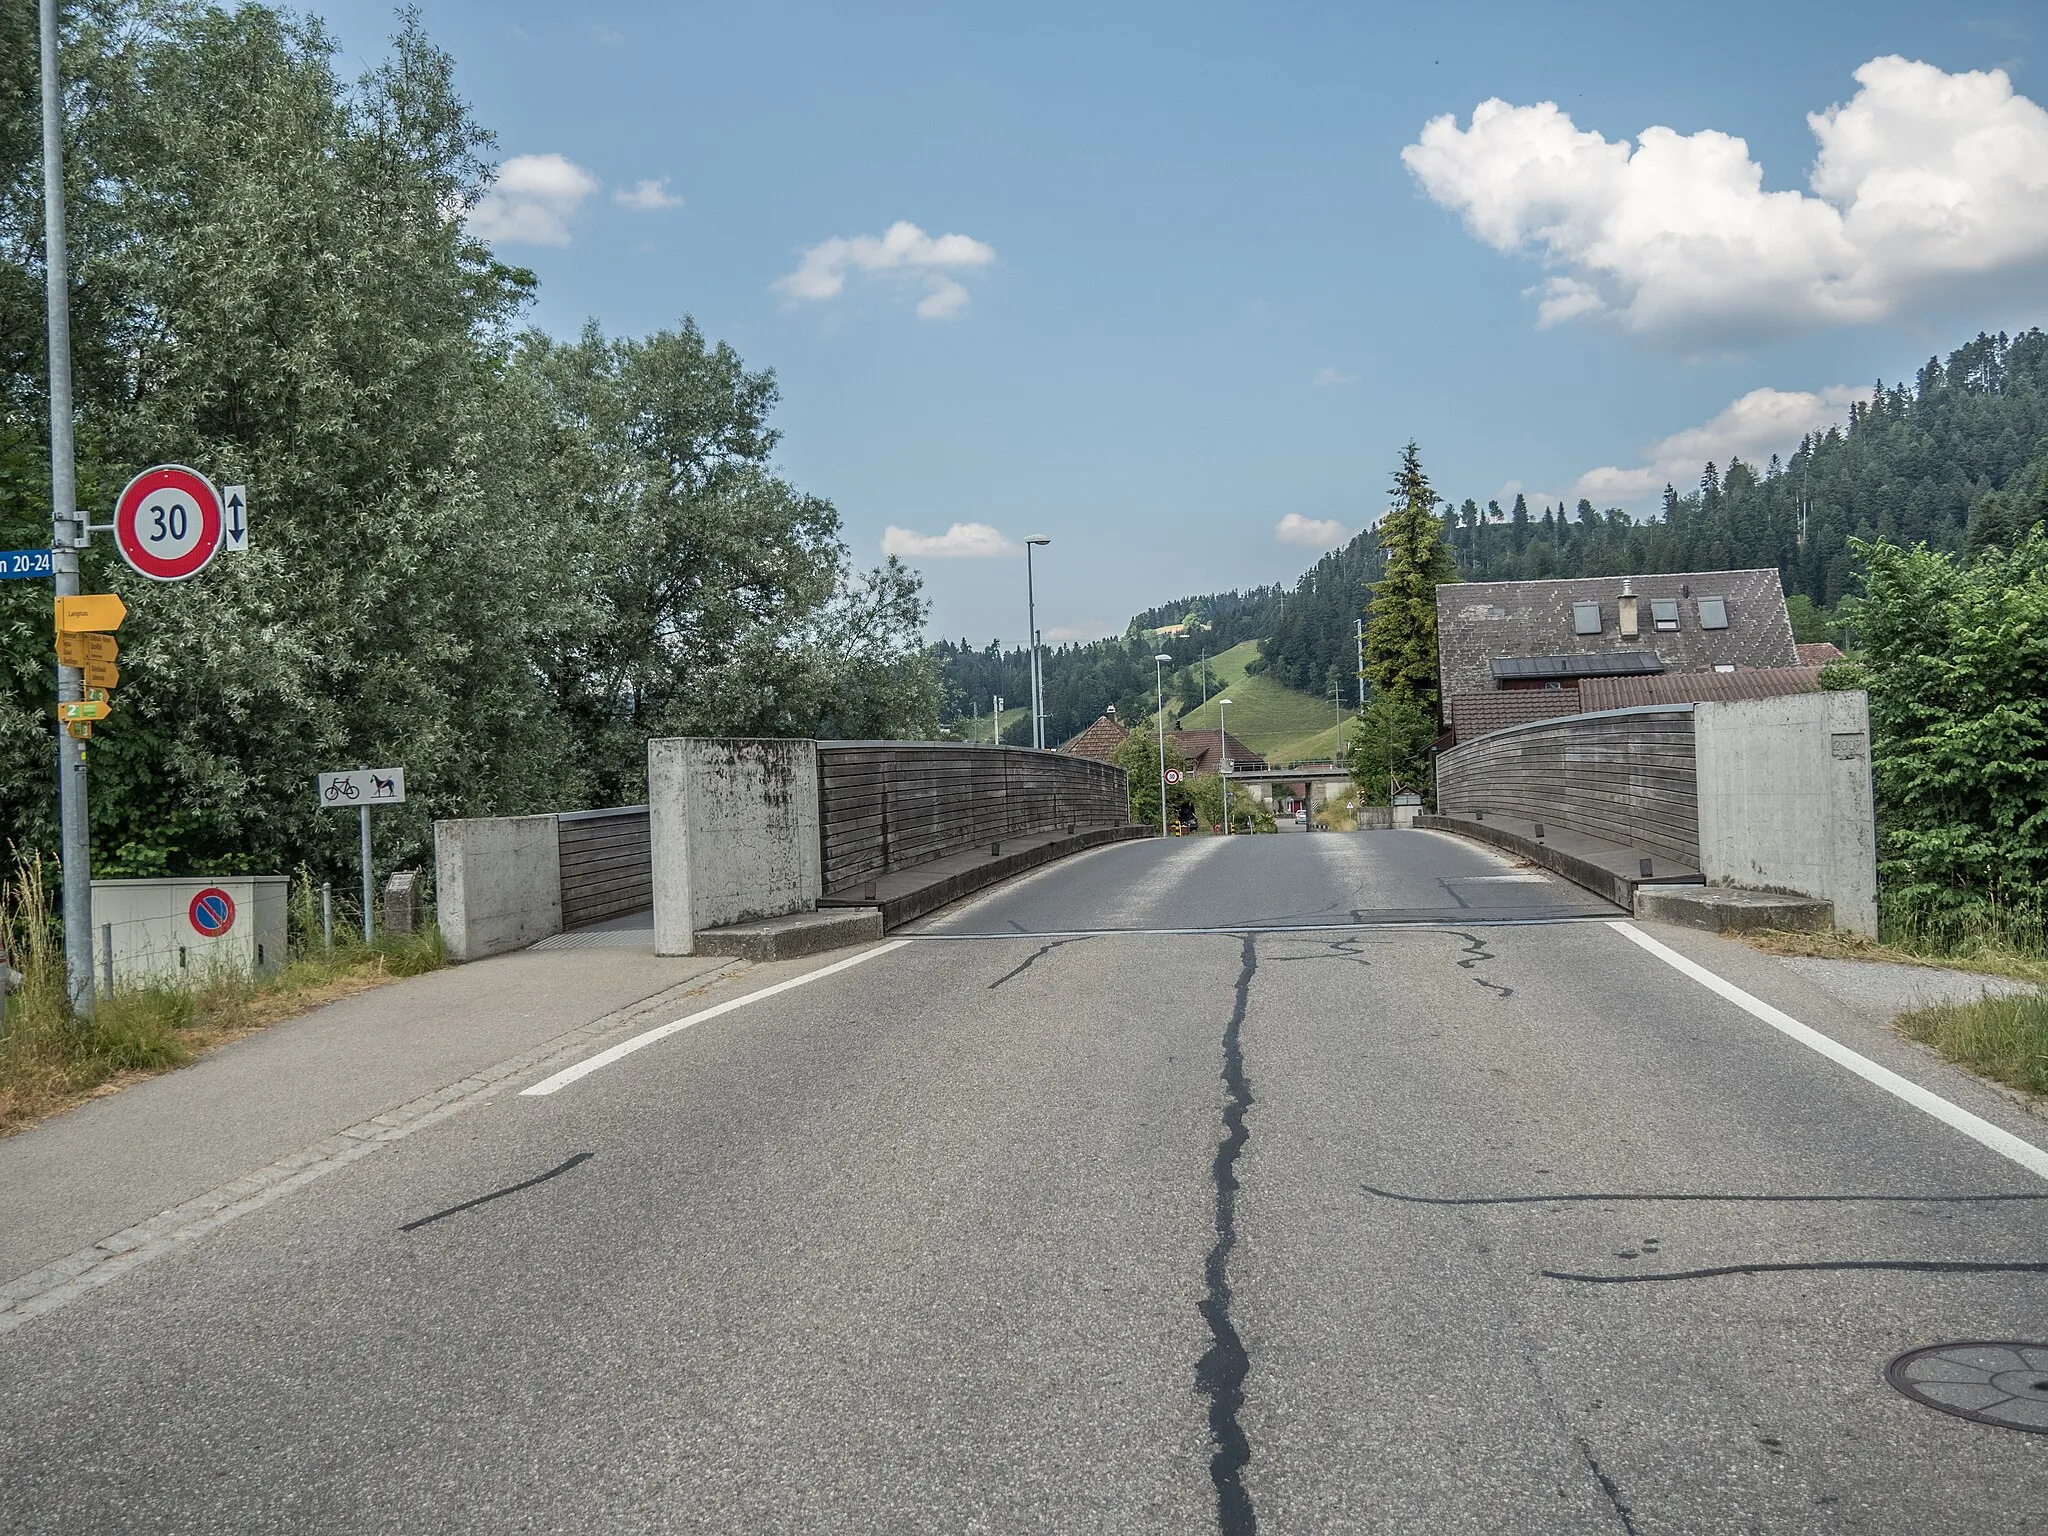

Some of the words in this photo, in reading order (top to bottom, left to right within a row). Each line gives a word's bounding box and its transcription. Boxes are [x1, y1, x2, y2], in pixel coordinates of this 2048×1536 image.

[150, 503, 188, 542] 30
[13, 554, 51, 572] 20-24
[67, 704, 77, 716] 2
